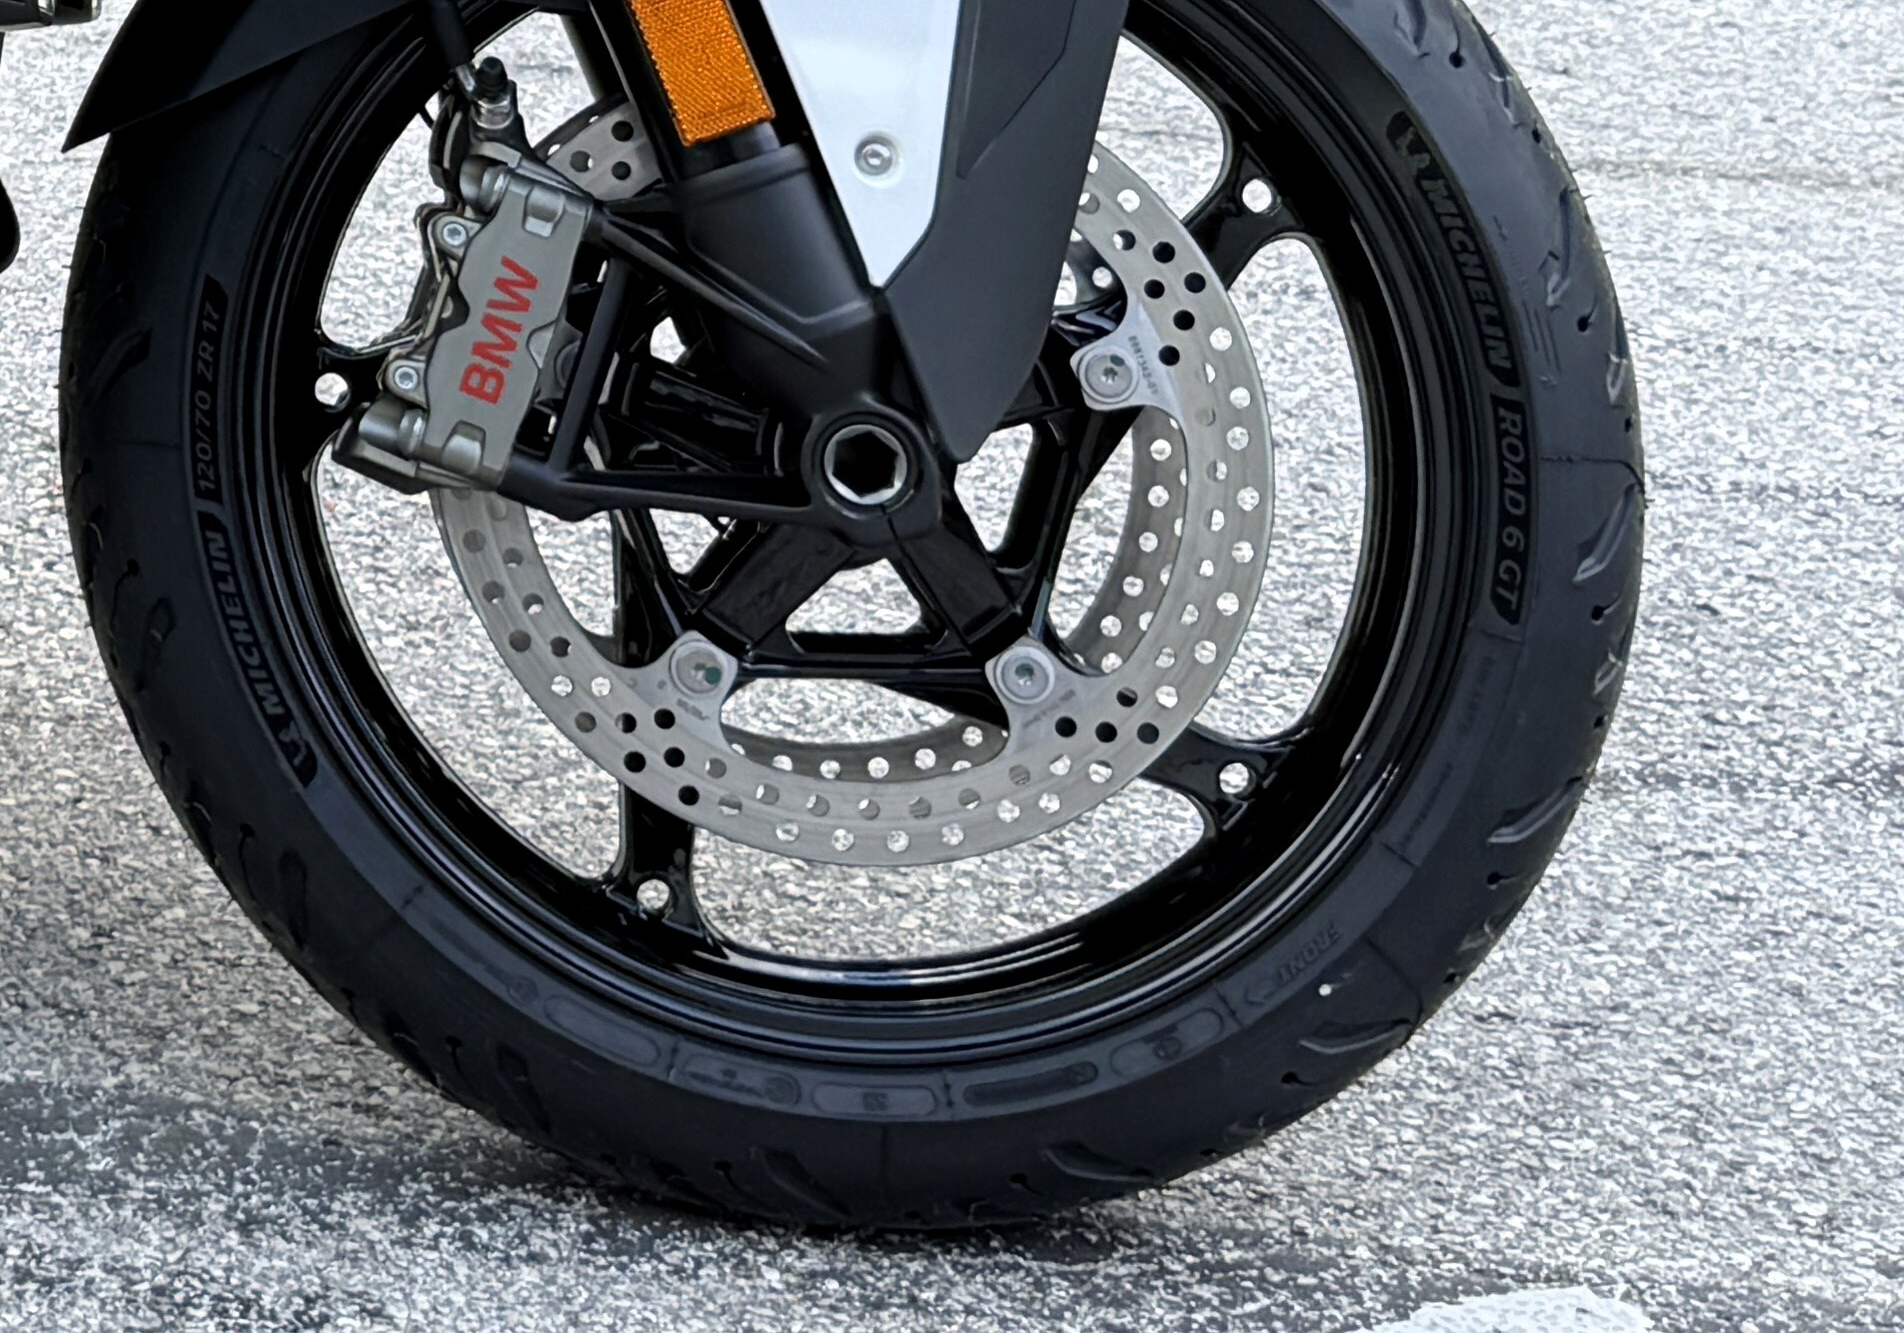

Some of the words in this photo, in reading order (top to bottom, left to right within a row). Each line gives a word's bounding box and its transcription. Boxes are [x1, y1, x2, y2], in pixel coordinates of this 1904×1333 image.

[204, 302, 219, 334] 17
[1421, 178, 1513, 370] MICHELIN
[197, 341, 215, 381] ZR
[459, 256, 539, 404] BMW
[195, 390, 216, 490] 120/70
[1498, 407, 1525, 517] ROAD
[1496, 558, 1522, 610] GT
[1502, 526, 1524, 552] 6
[205, 531, 285, 715] MICHELIN
